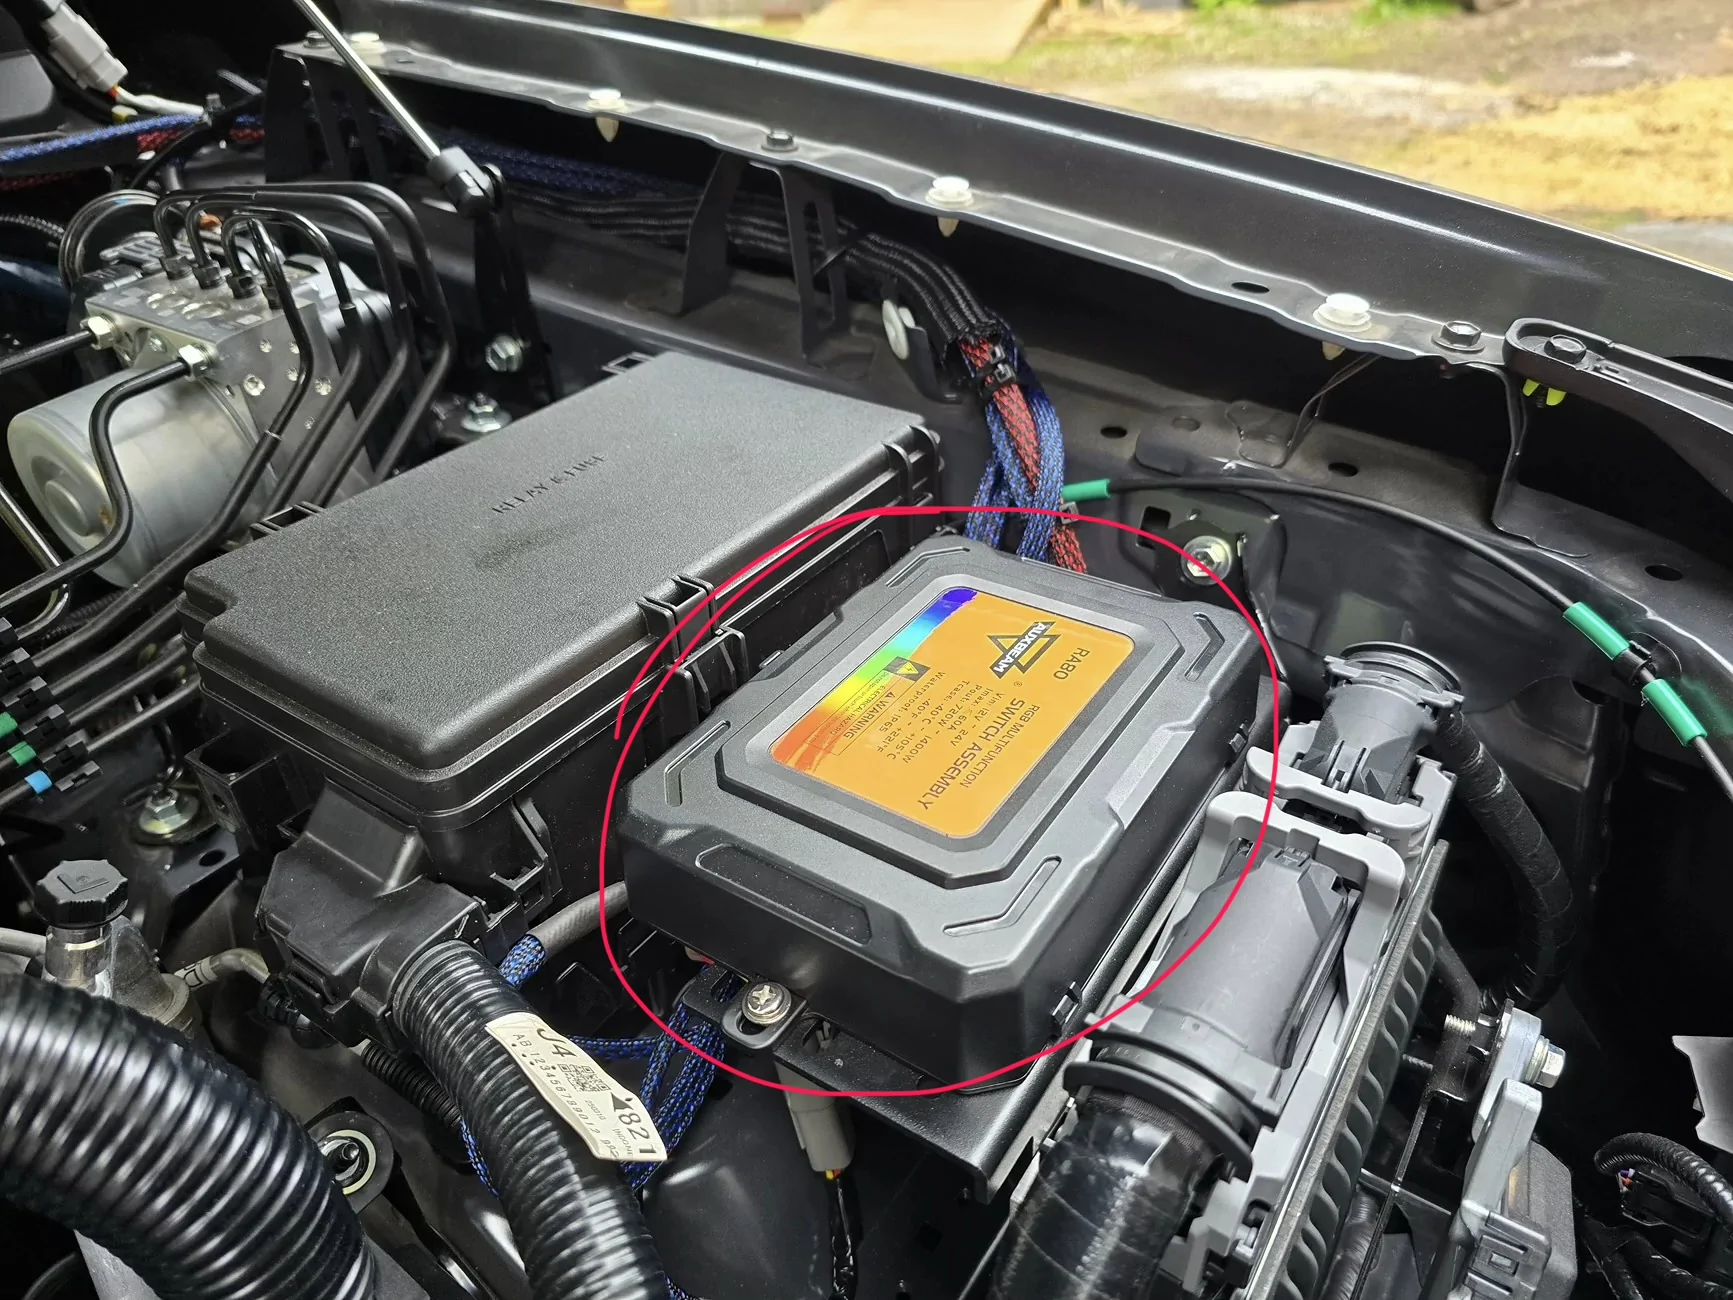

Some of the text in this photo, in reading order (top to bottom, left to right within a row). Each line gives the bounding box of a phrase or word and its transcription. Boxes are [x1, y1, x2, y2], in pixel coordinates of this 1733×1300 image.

[991, 621, 1050, 673] AUXBEAM
[1050, 646, 1091, 680] RA80
[852, 684, 887, 713] ELECTRICAL
[896, 670, 946, 714] Waterproof:
[959, 683, 983, 703] Pout:
[984, 691, 1005, 707] Vin:
[828, 712, 857, 736] HAZARD
[841, 699, 889, 739] WARNING
[877, 713, 902, 733] IP65
[935, 703, 964, 727] 720W
[900, 734, 933, 764] 1400W
[947, 728, 970, 747] 24V
[958, 703, 1040, 788] RGB MULTIFUNCTION
[913, 697, 1026, 810] SWITCH ASSEMBLY
[512, 1034, 533, 1048] AB
[536, 1028, 577, 1058] J4
